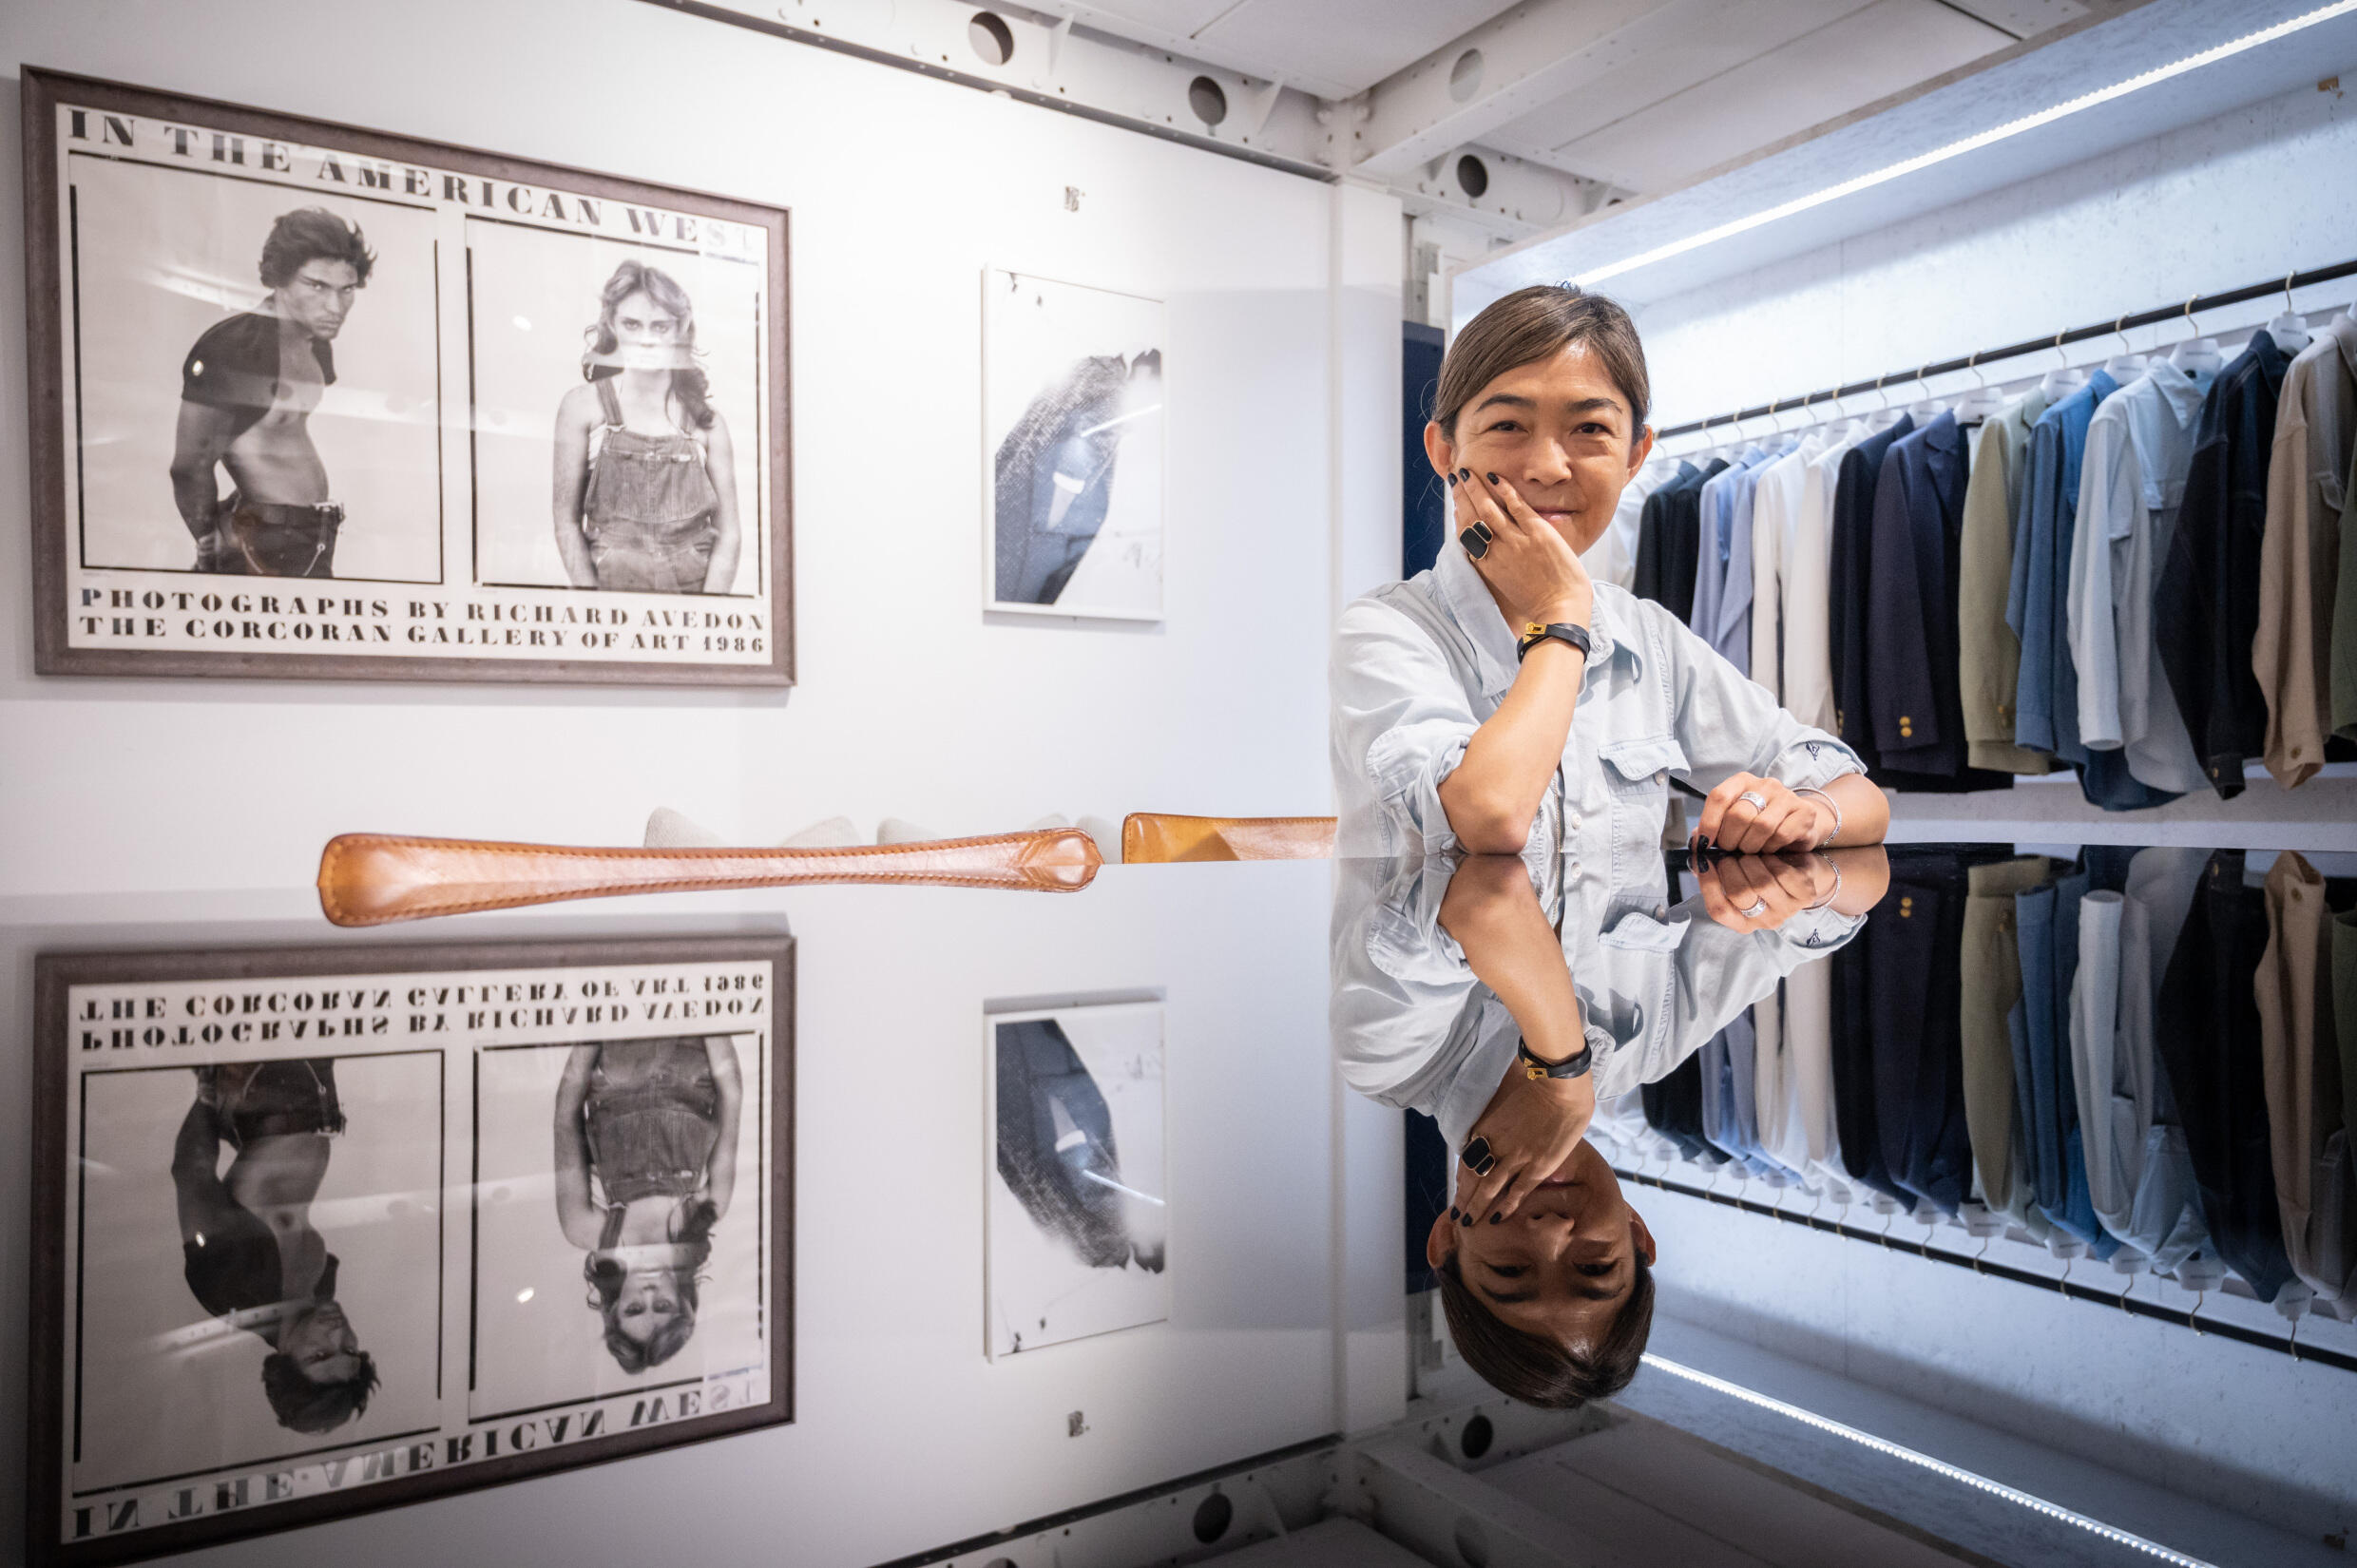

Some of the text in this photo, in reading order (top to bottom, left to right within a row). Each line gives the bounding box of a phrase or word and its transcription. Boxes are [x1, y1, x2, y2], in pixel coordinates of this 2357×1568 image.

[67, 108, 135, 146] IN
[163, 124, 292, 173] THE
[316, 152, 602, 227] AMERICAN
[80, 587, 765, 631] PHOTOGRAPHS BY RICHARD AVEDON
[80, 617, 764, 653] THE CORCORAN GALLERY OF ART 1986
